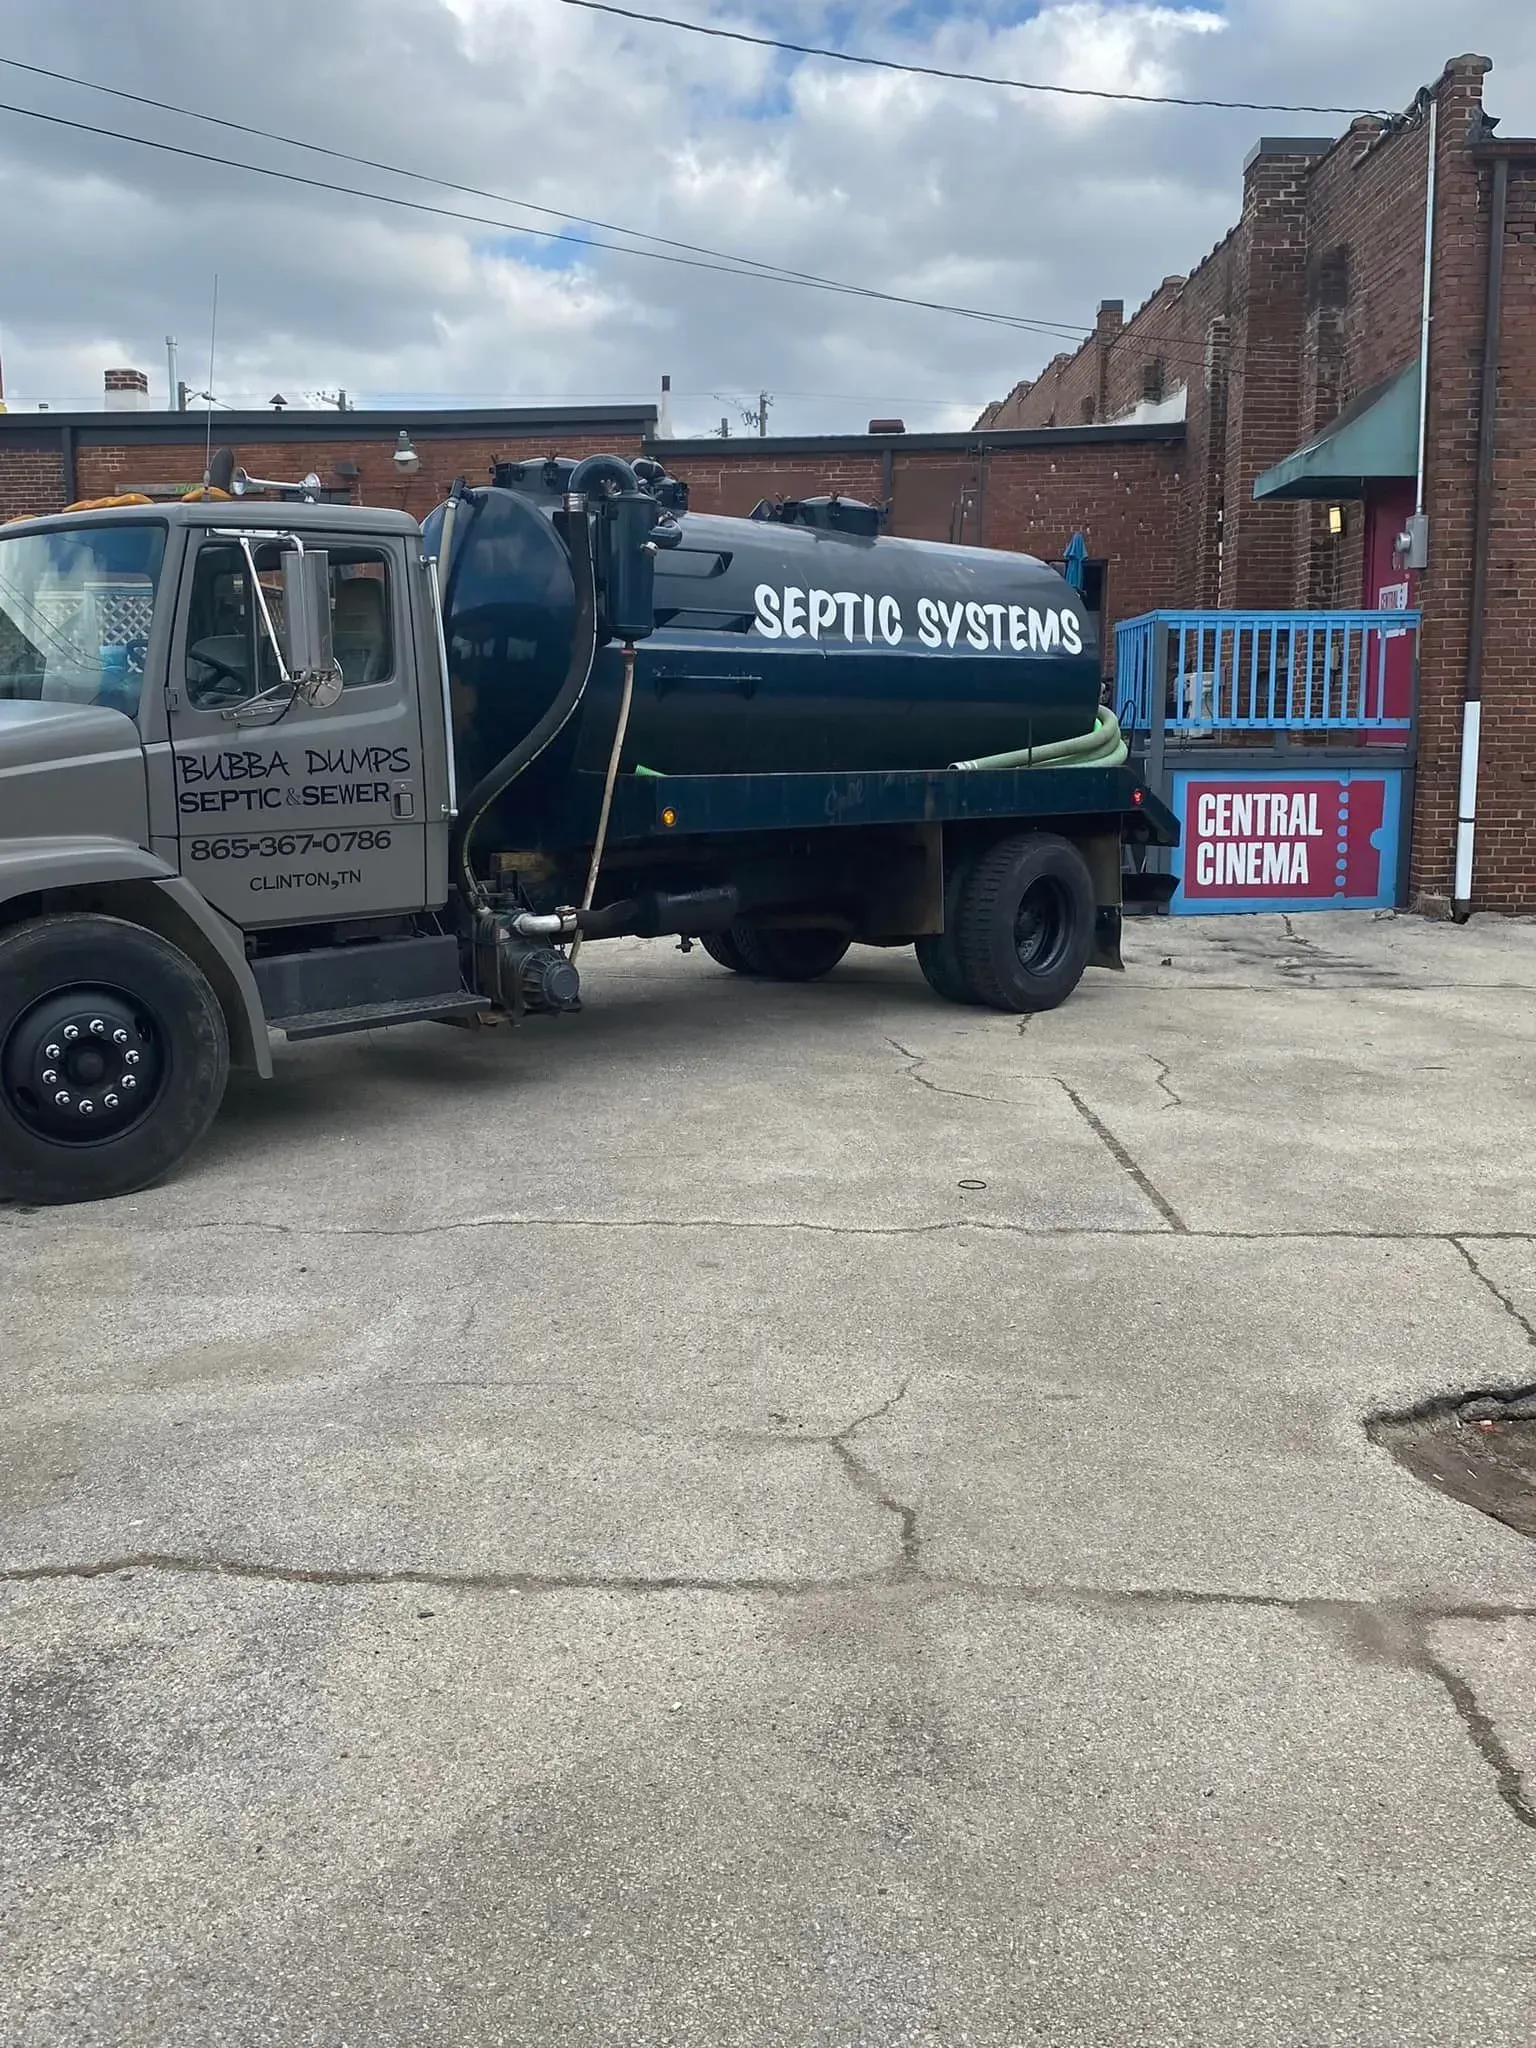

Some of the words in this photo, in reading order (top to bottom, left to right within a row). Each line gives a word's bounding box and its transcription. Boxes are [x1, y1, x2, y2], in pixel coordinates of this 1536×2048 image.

[754, 584, 903, 646] SEPTIC
[917, 597, 1083, 655] SYSTEMS
[177, 750, 290, 784] BUBBA
[305, 747, 411, 775] DUMPS
[1197, 793, 1324, 837] CENTRAL
[190, 830, 392, 861] 865-367-0786
[1196, 841, 1310, 886] CINEMA
